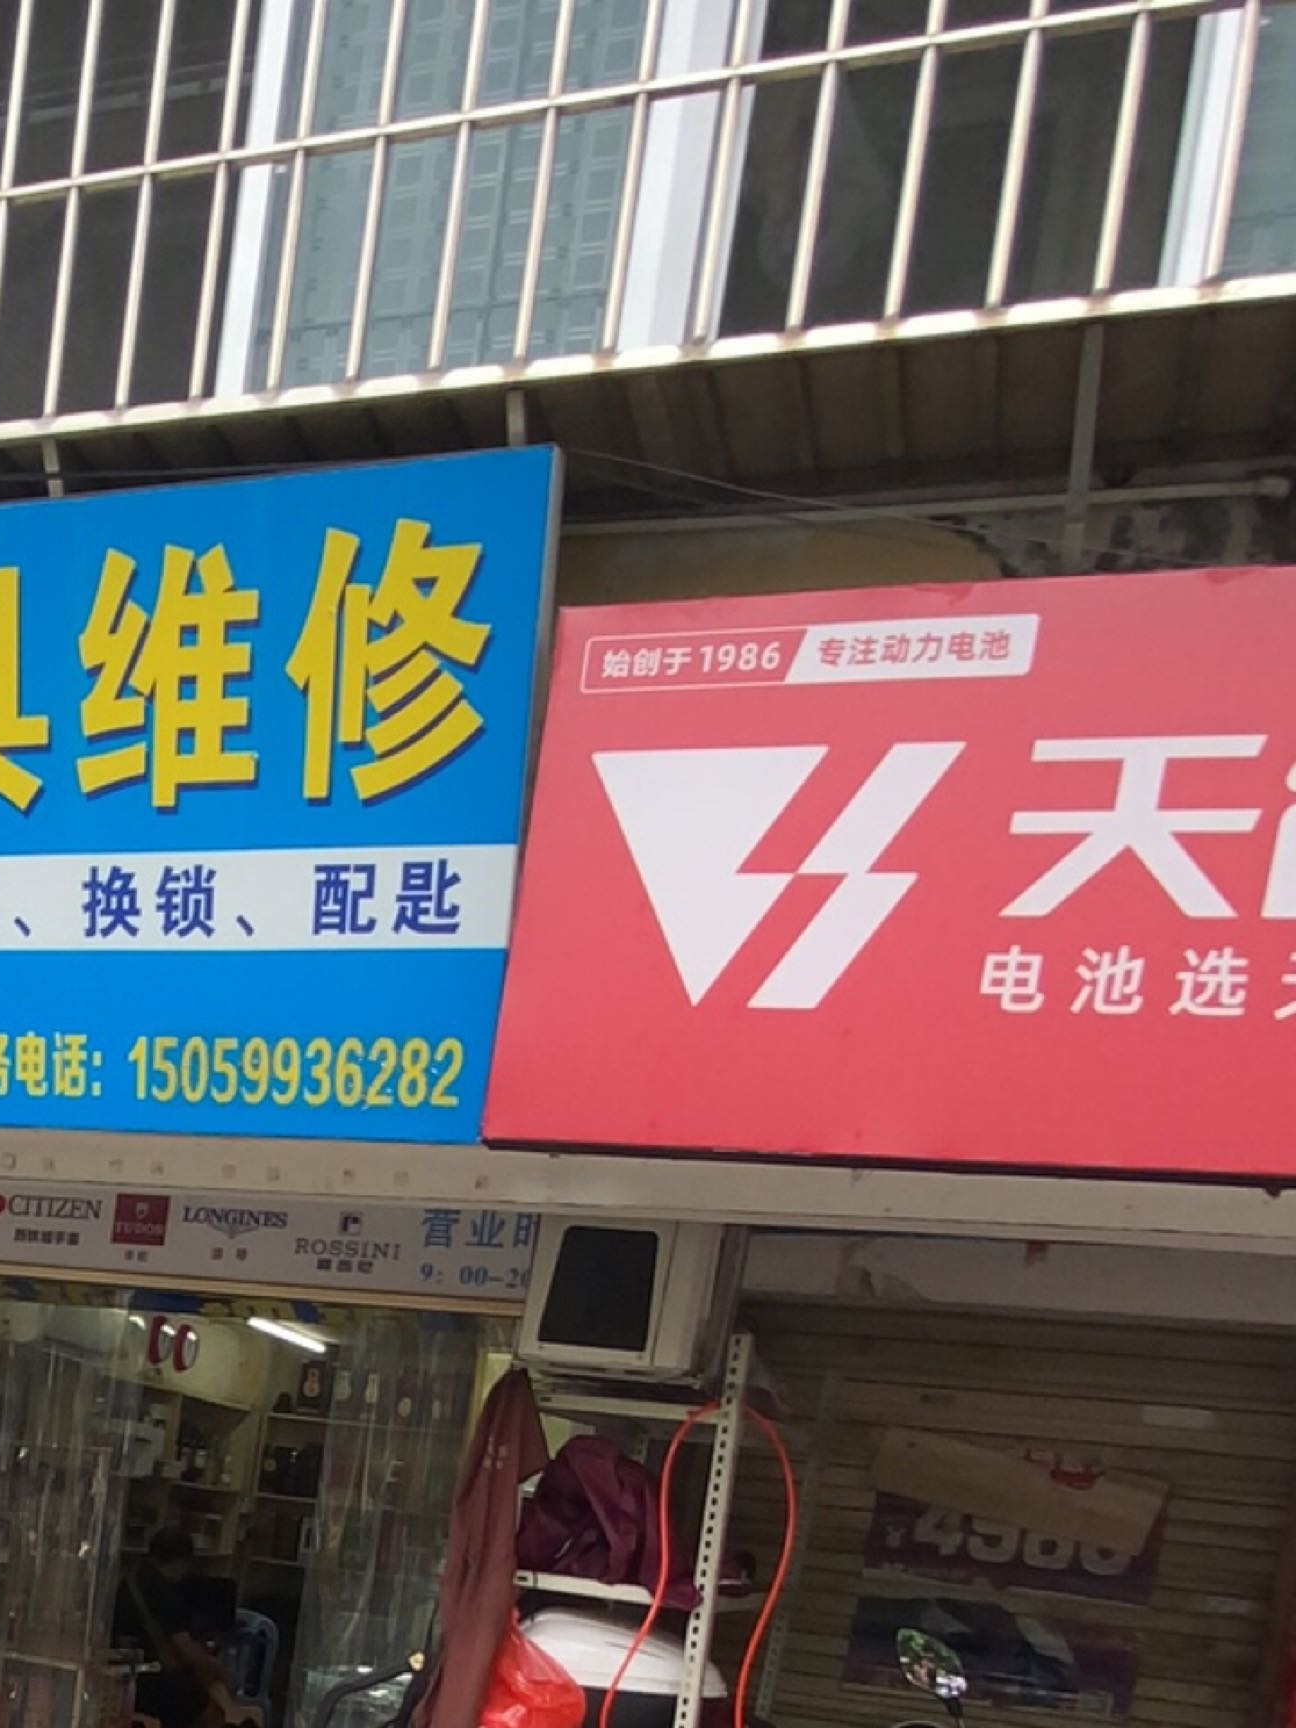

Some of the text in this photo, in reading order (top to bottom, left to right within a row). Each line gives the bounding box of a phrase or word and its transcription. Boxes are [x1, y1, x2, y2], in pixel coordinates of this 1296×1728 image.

[816, 628, 1011, 669] 专注动力电池
[998, 734, 1296, 920] 天
[978, 945, 1296, 1020] 电池选
[127, 1035, 465, 1109] 15059936282
[8, 1194, 103, 1220] CITIZEN
[182, 1206, 287, 1228] LONGINES
[294, 1236, 402, 1262] ROSSINI
